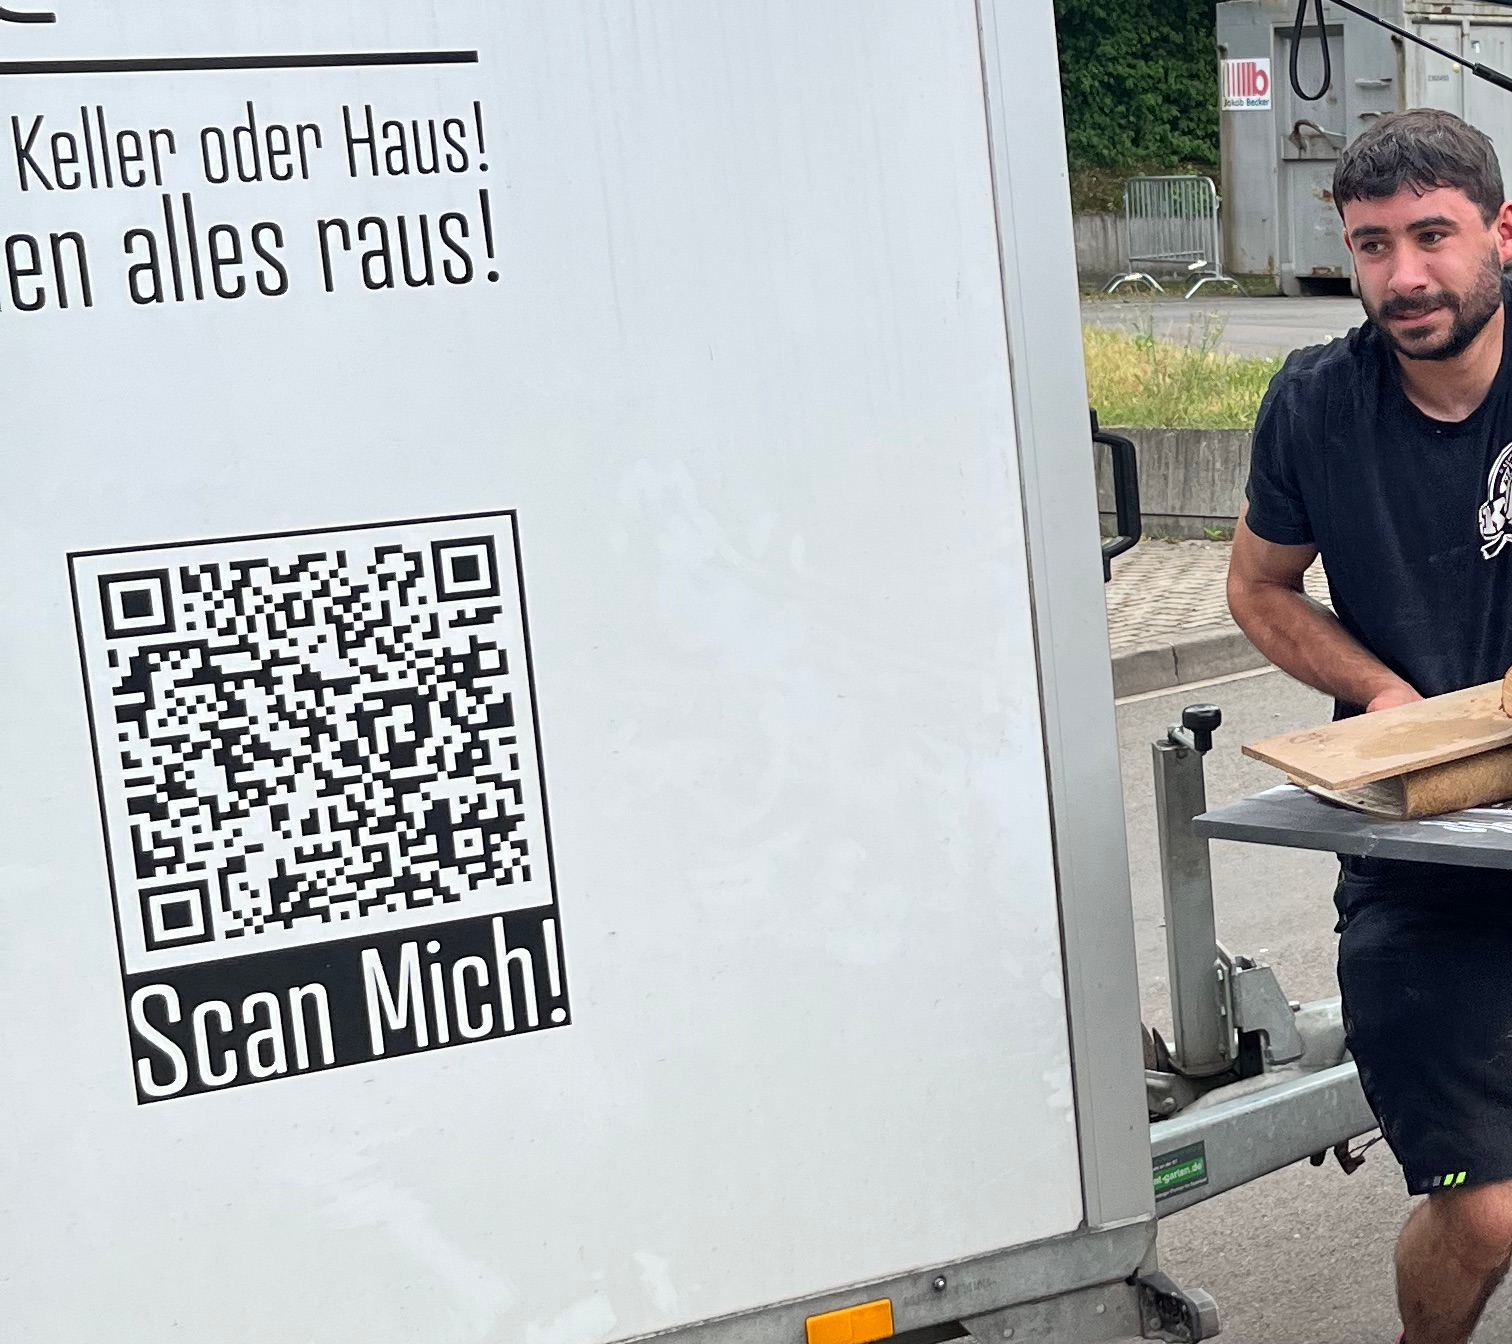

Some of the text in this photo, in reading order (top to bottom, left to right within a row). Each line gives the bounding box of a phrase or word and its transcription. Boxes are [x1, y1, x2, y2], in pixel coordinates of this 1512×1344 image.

[11, 100, 490, 191] Keller oder Haus!
[0, 188, 501, 312] en alles raus!
[130, 916, 567, 1098] Scan Mich!
